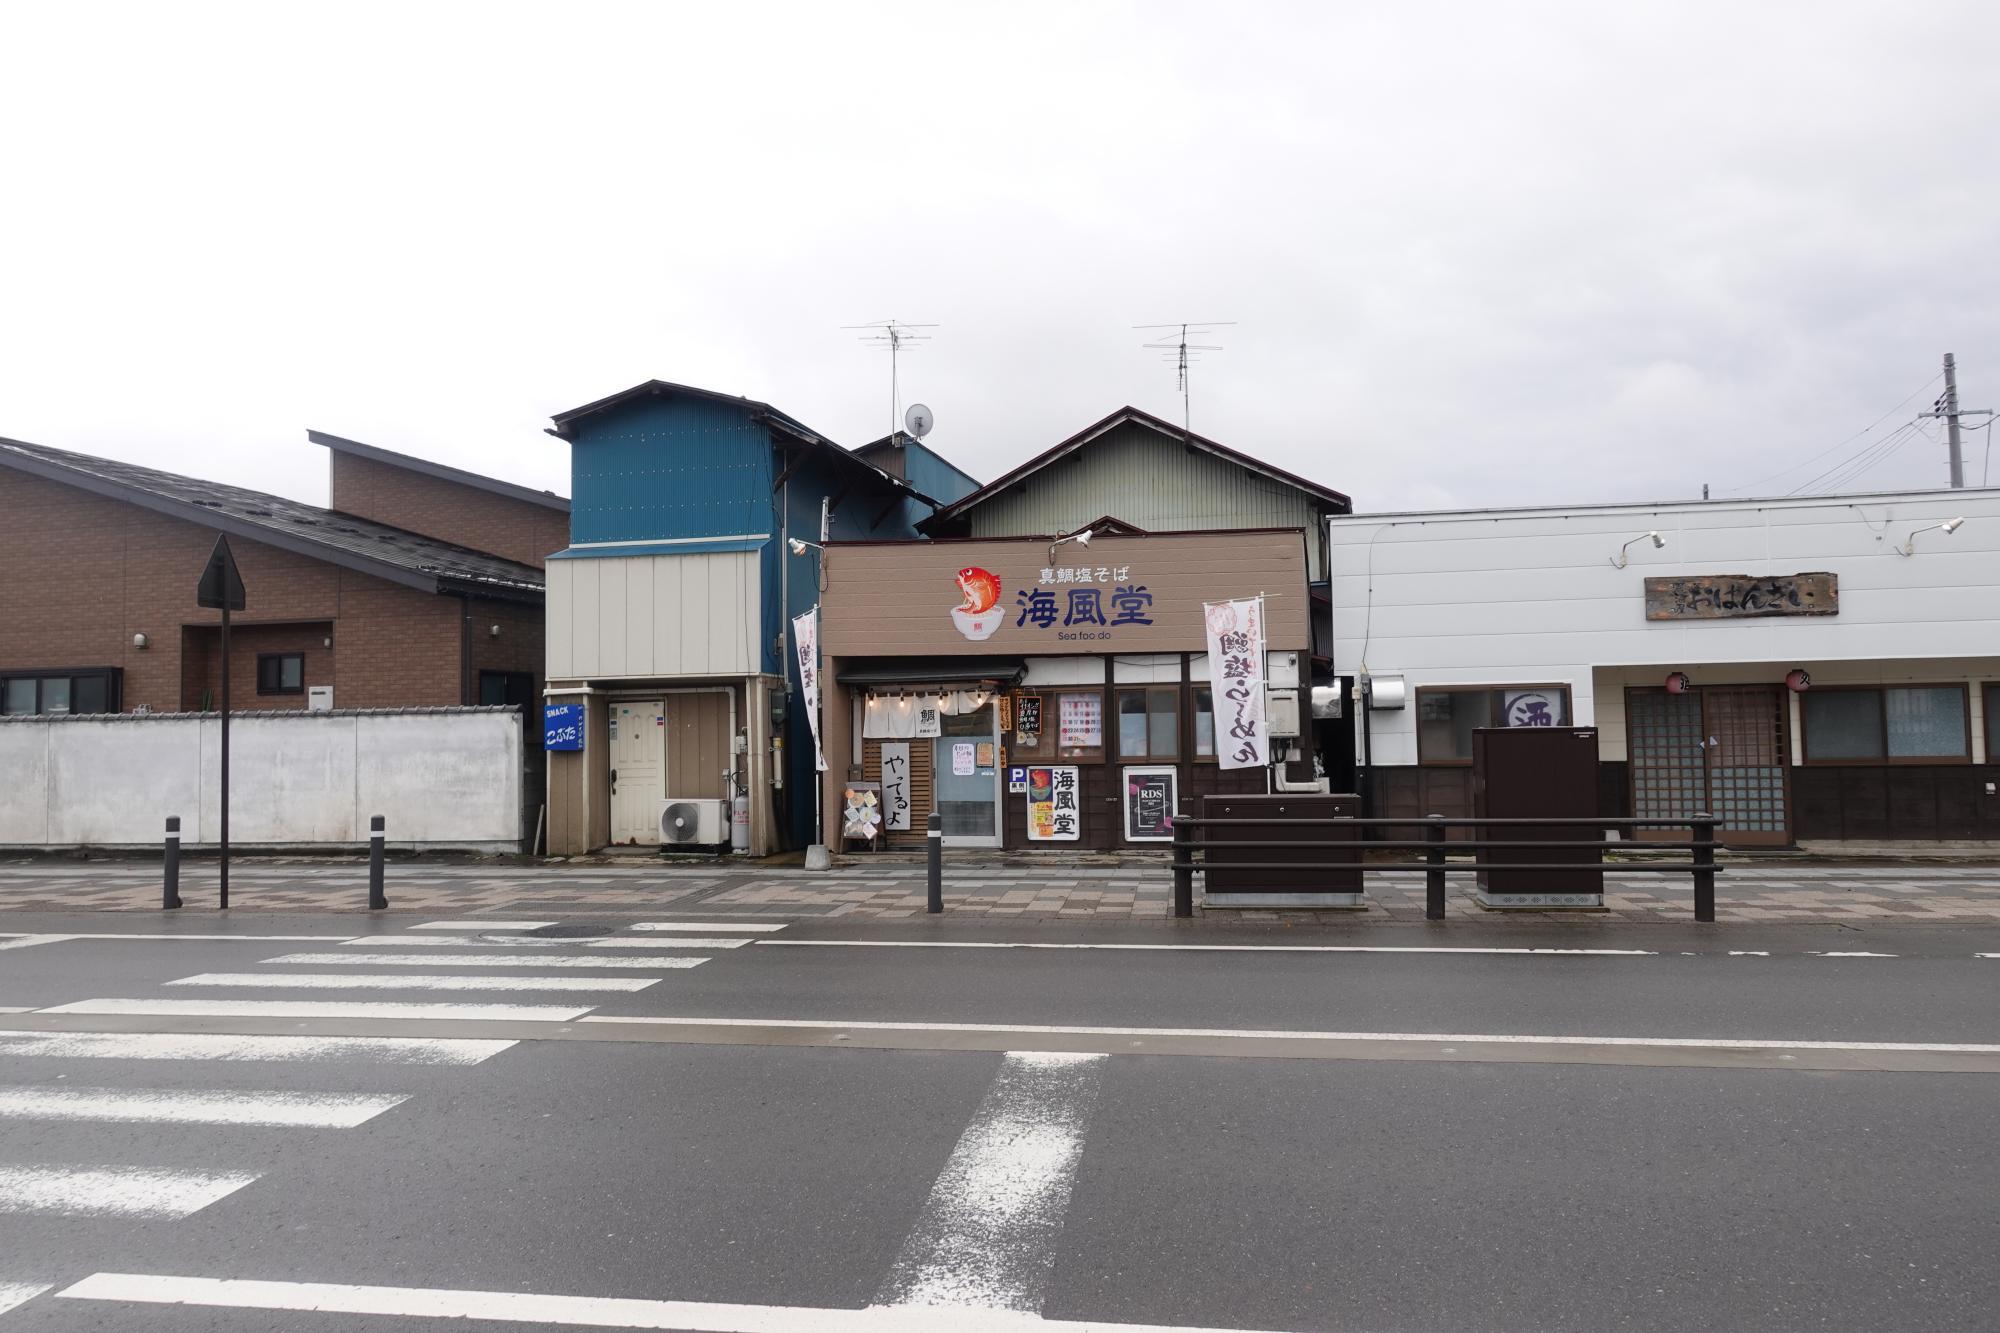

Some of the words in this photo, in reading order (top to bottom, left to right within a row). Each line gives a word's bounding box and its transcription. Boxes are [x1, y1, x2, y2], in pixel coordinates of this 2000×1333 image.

[1038, 566, 1130, 585] 真鯛塩そば
[1016, 584, 1154, 628] 海風堂
[1058, 631, 1077, 641] Sea
[1098, 631, 1111, 640] do
[546, 706, 569, 718] SNACK
[920, 709, 935, 722] 鯛
[546, 726, 576, 745] こぶた
[1012, 768, 1024, 782] P
[884, 755, 909, 826] やってるよ
[1141, 789, 1163, 799] RDS
[1053, 770, 1076, 835] 海風堂
